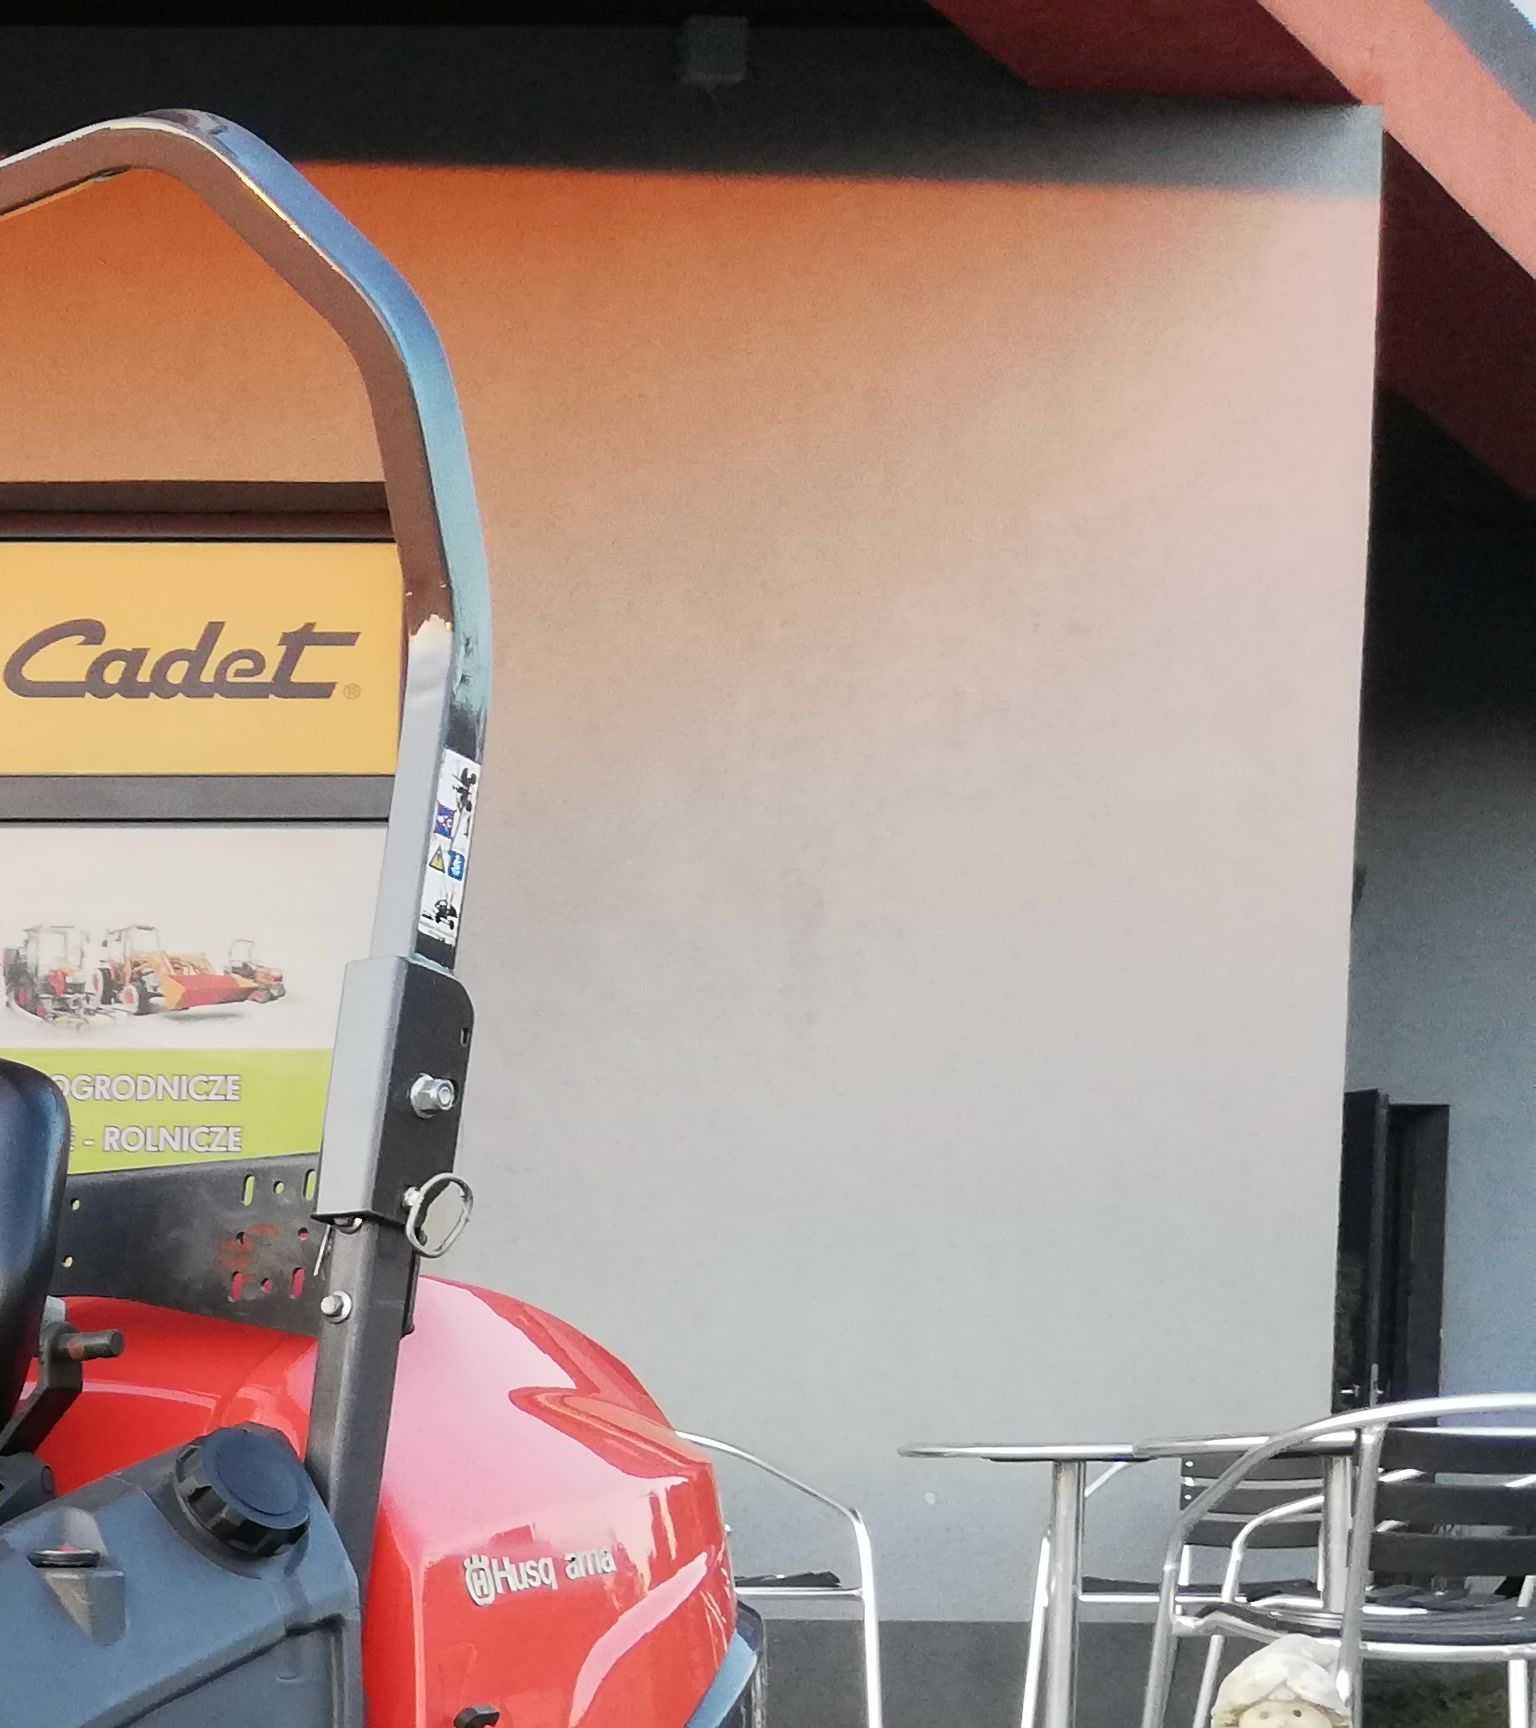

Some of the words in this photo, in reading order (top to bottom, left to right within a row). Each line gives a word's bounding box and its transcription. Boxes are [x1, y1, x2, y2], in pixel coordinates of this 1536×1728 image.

[3, 618, 362, 700] Cadet
[53, 1074, 242, 1101] OGRODNICZE
[103, 1126, 242, 1152] ROLNICZE
